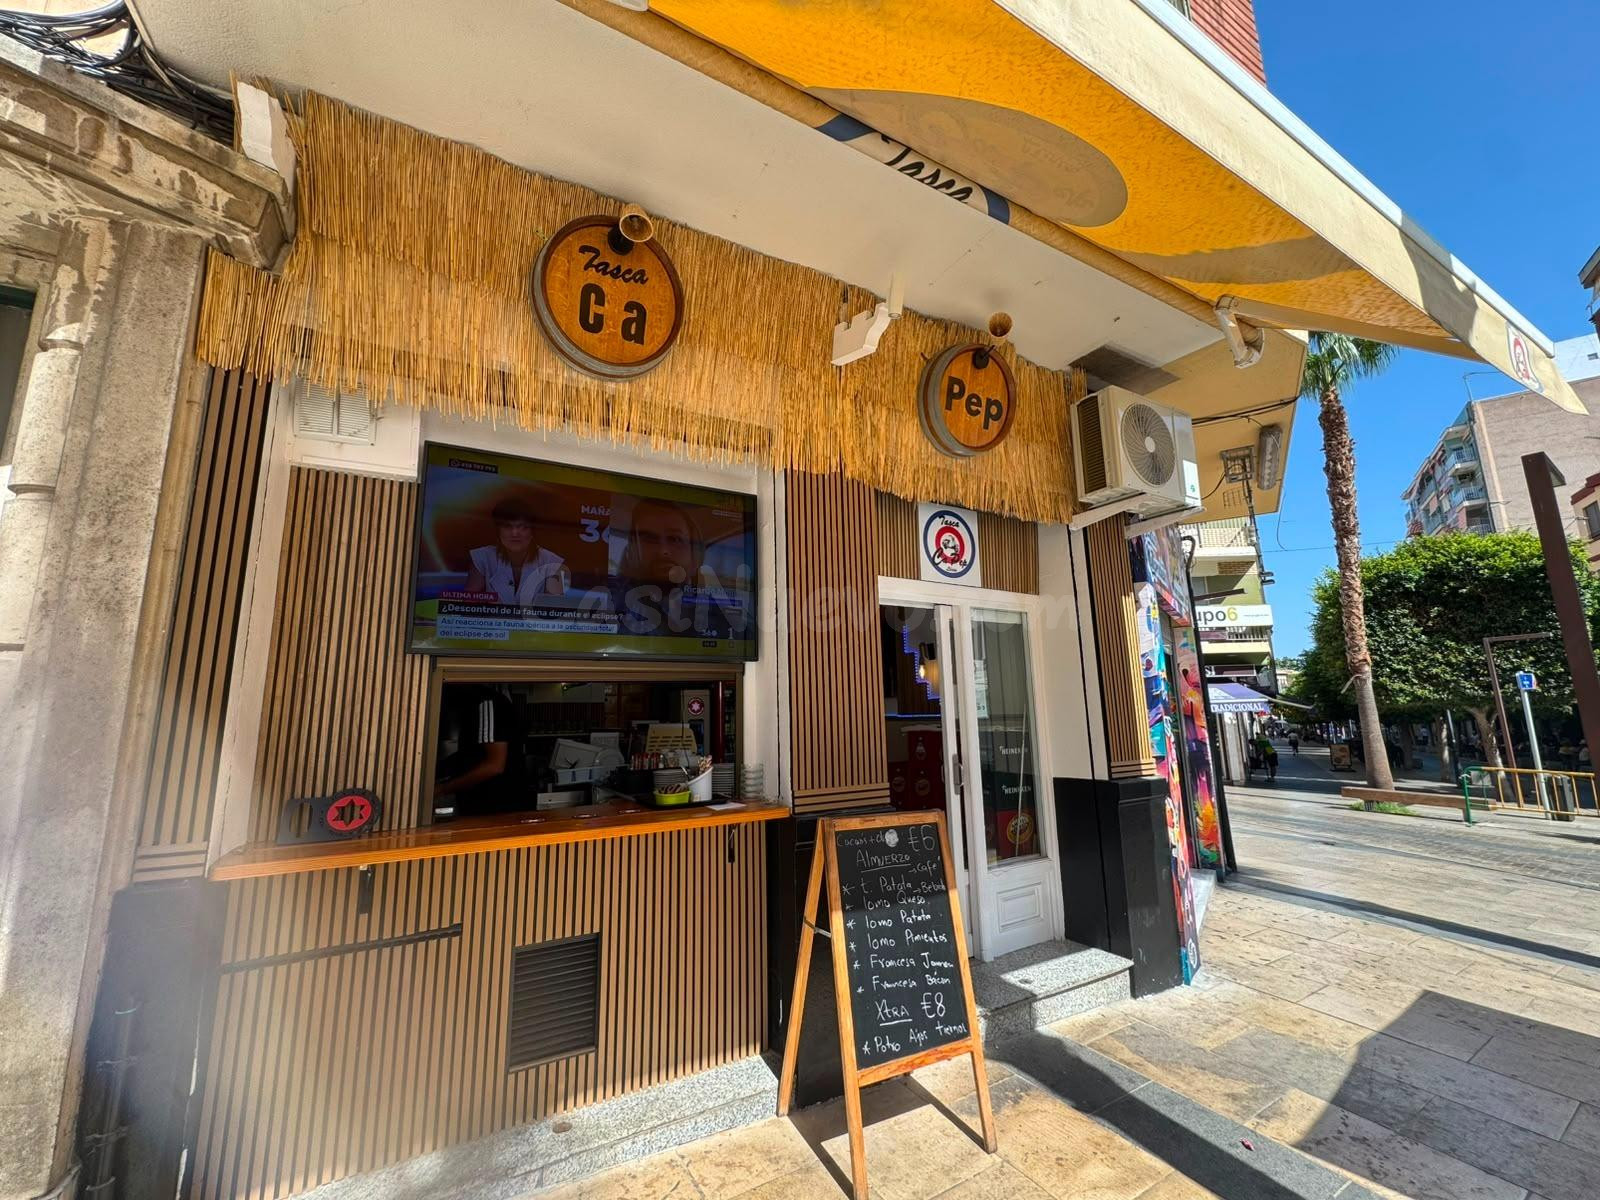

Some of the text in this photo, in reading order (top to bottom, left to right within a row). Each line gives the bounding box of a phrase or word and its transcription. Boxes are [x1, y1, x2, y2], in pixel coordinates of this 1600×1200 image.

[578, 244, 649, 285] Tasca
[945, 375, 1003, 431] Pep
[442, 603, 499, 614] ¿Descontrol
[500, 607, 512, 615] de
[522, 607, 548, 617] fauna
[549, 609, 582, 618] durante
